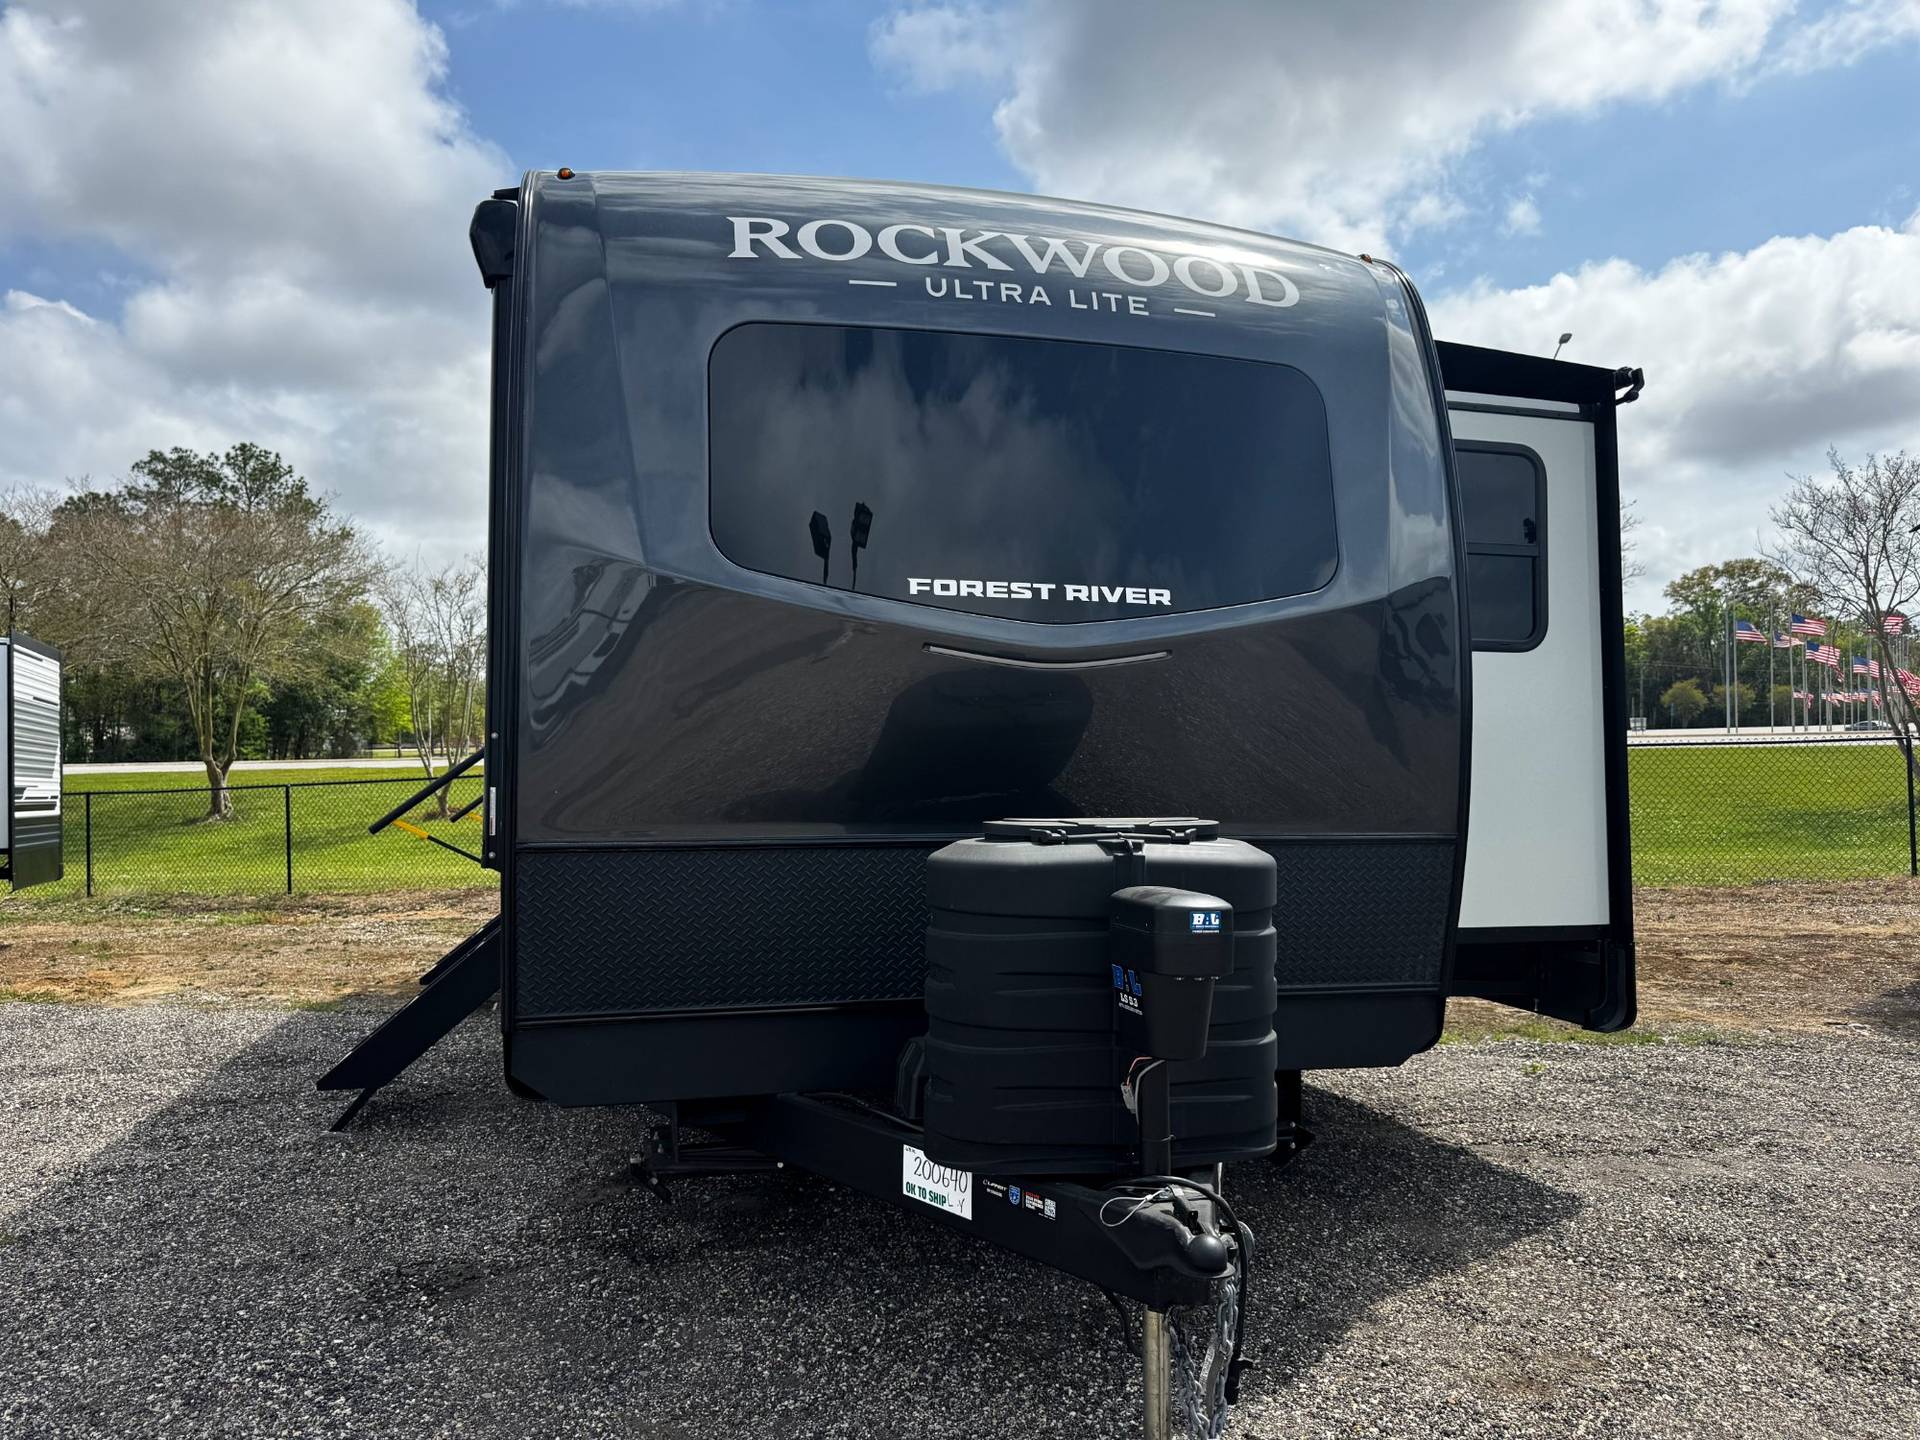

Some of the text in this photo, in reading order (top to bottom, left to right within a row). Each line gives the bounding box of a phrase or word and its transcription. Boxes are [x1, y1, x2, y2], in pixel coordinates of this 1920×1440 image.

[726, 216, 1300, 308] ROCKWOOD
[925, 277, 1149, 316] ULTRA LITE
[907, 577, 1172, 606] FOREST RIVER
[905, 1181, 947, 1207] OK TO SHIP
[913, 1156, 969, 1194] 200640
